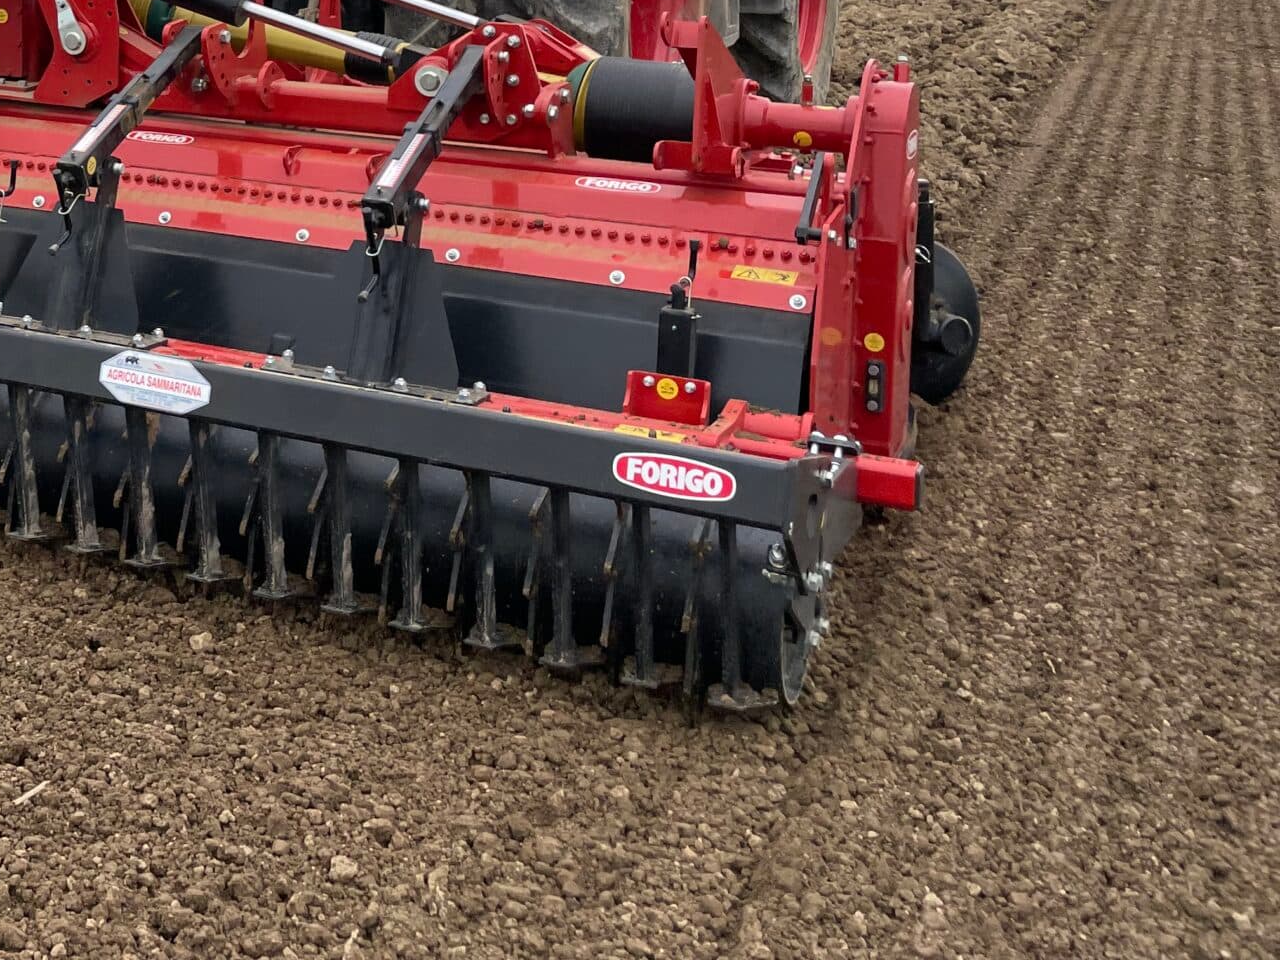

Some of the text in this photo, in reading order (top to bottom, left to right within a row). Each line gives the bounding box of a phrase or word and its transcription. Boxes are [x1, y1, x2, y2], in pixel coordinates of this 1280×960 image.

[134, 131, 187, 143] FORIGO
[584, 178, 652, 192] FORIGO
[107, 368, 145, 386] AGRICOLA
[146, 375, 202, 397] SAMMARITANA
[626, 457, 723, 496] FORIGO
